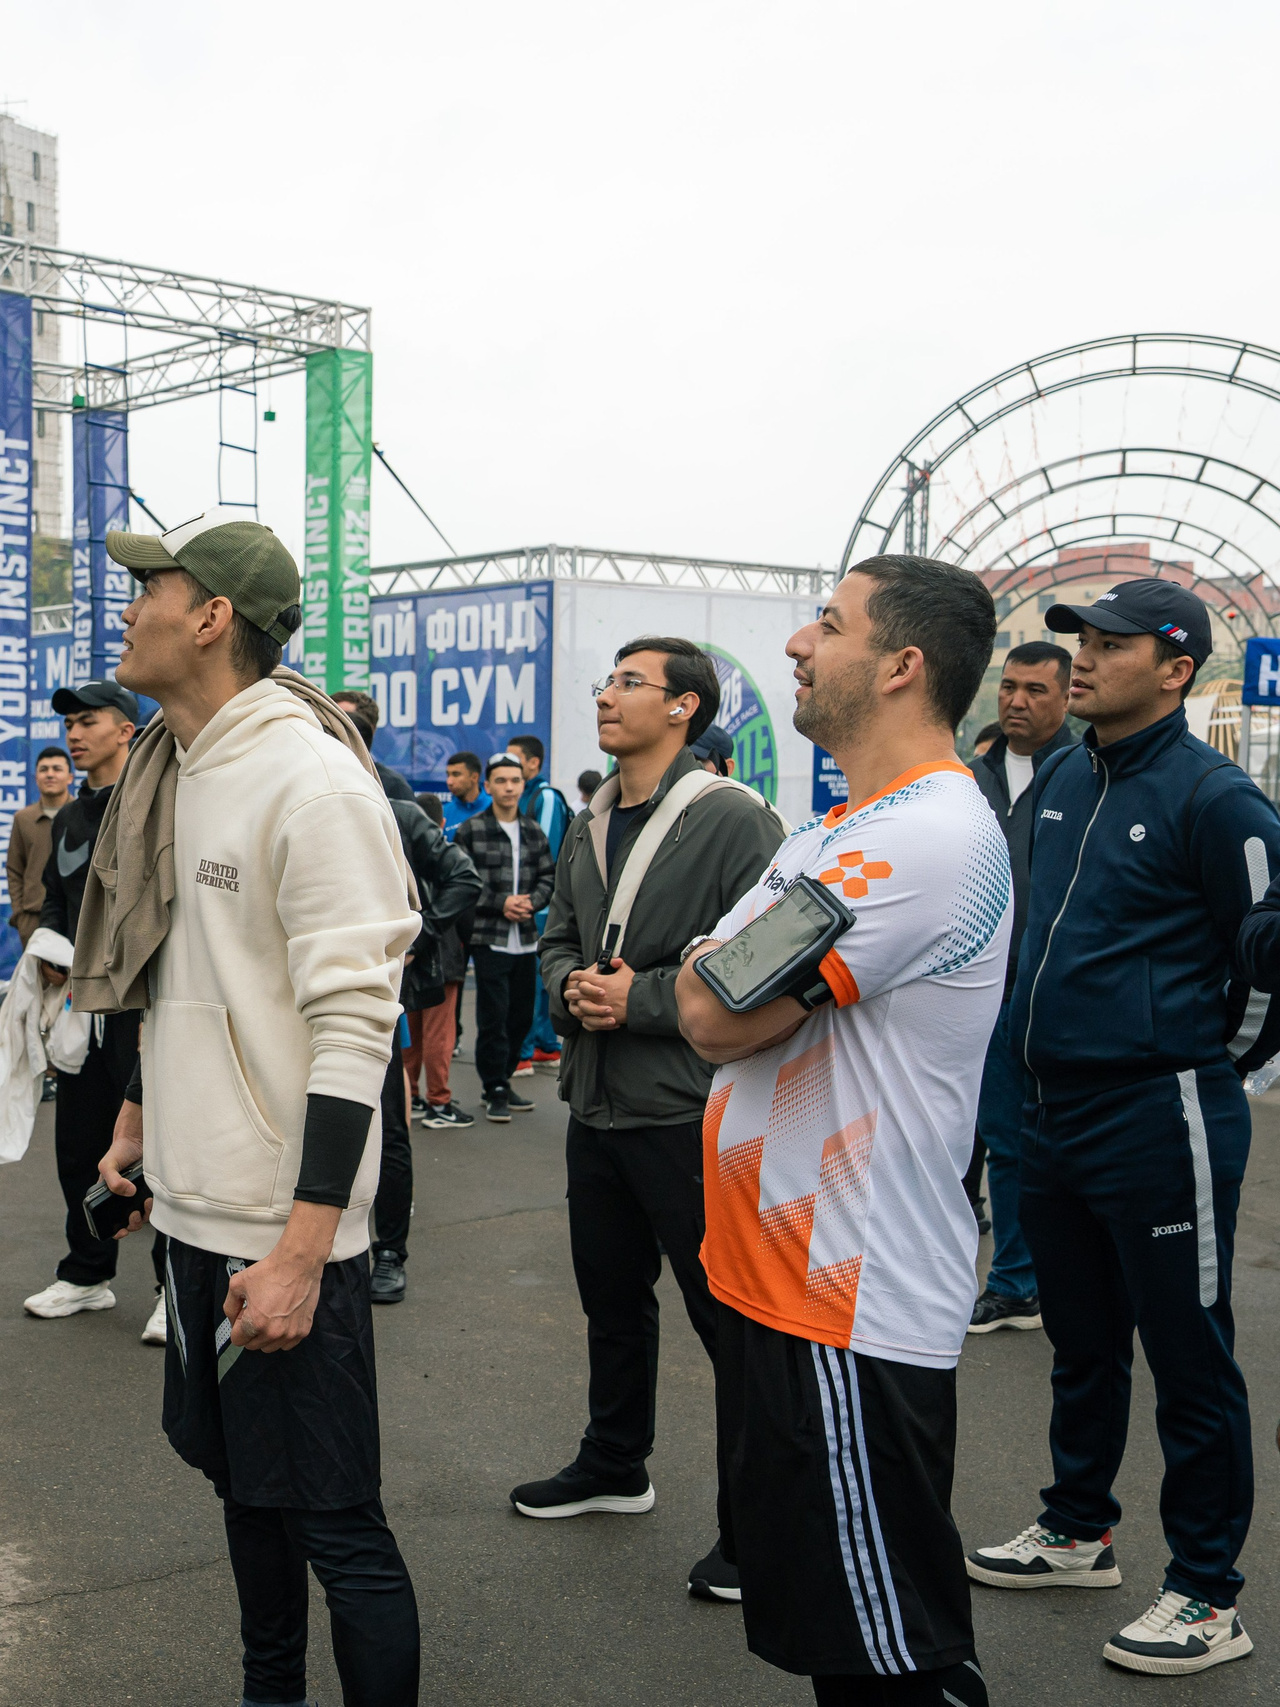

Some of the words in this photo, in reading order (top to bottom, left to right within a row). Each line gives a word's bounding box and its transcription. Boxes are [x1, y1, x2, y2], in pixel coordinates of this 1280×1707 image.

[305, 474, 330, 638] INSTINCT
[73, 547, 92, 687] ERGY.UZ
[343, 509, 370, 692] NERGY.UZ
[426, 600, 537, 655] ФОНД
[430, 662, 536, 726] СУМ
[195, 871, 240, 893] EXPERIENCE
[198, 858, 238, 880] ELEVATED
